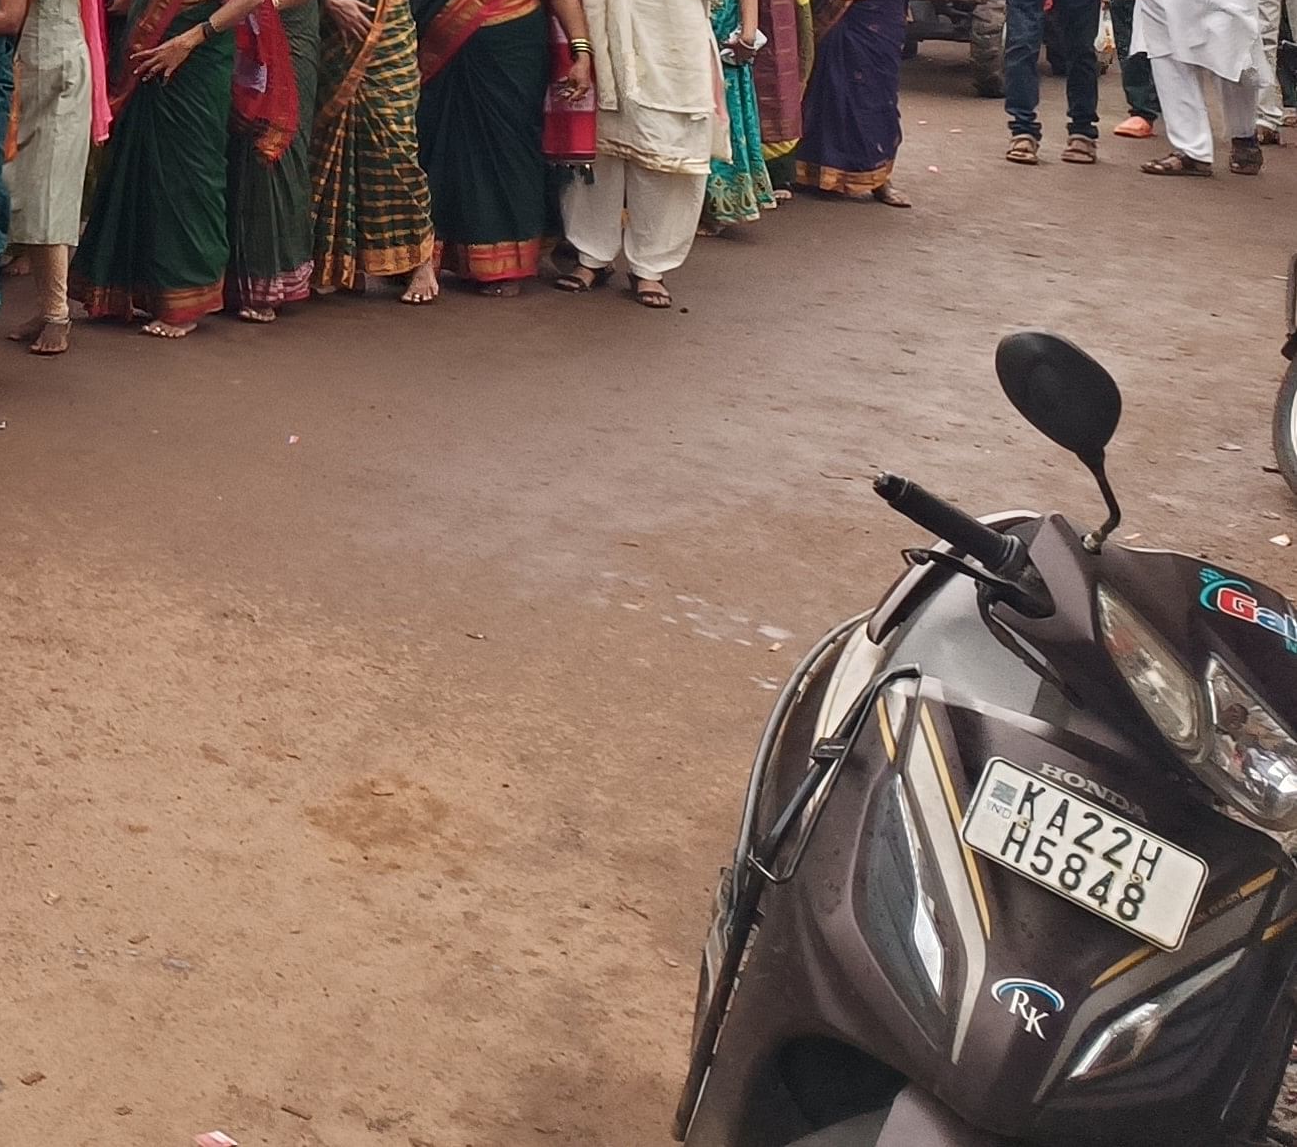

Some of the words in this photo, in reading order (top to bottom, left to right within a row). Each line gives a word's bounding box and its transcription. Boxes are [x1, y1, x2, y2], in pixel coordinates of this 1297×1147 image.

[1016, 780, 1163, 881] KA22H
[1039, 762, 1148, 823] HONDA
[1000, 820, 1146, 922] H5848
